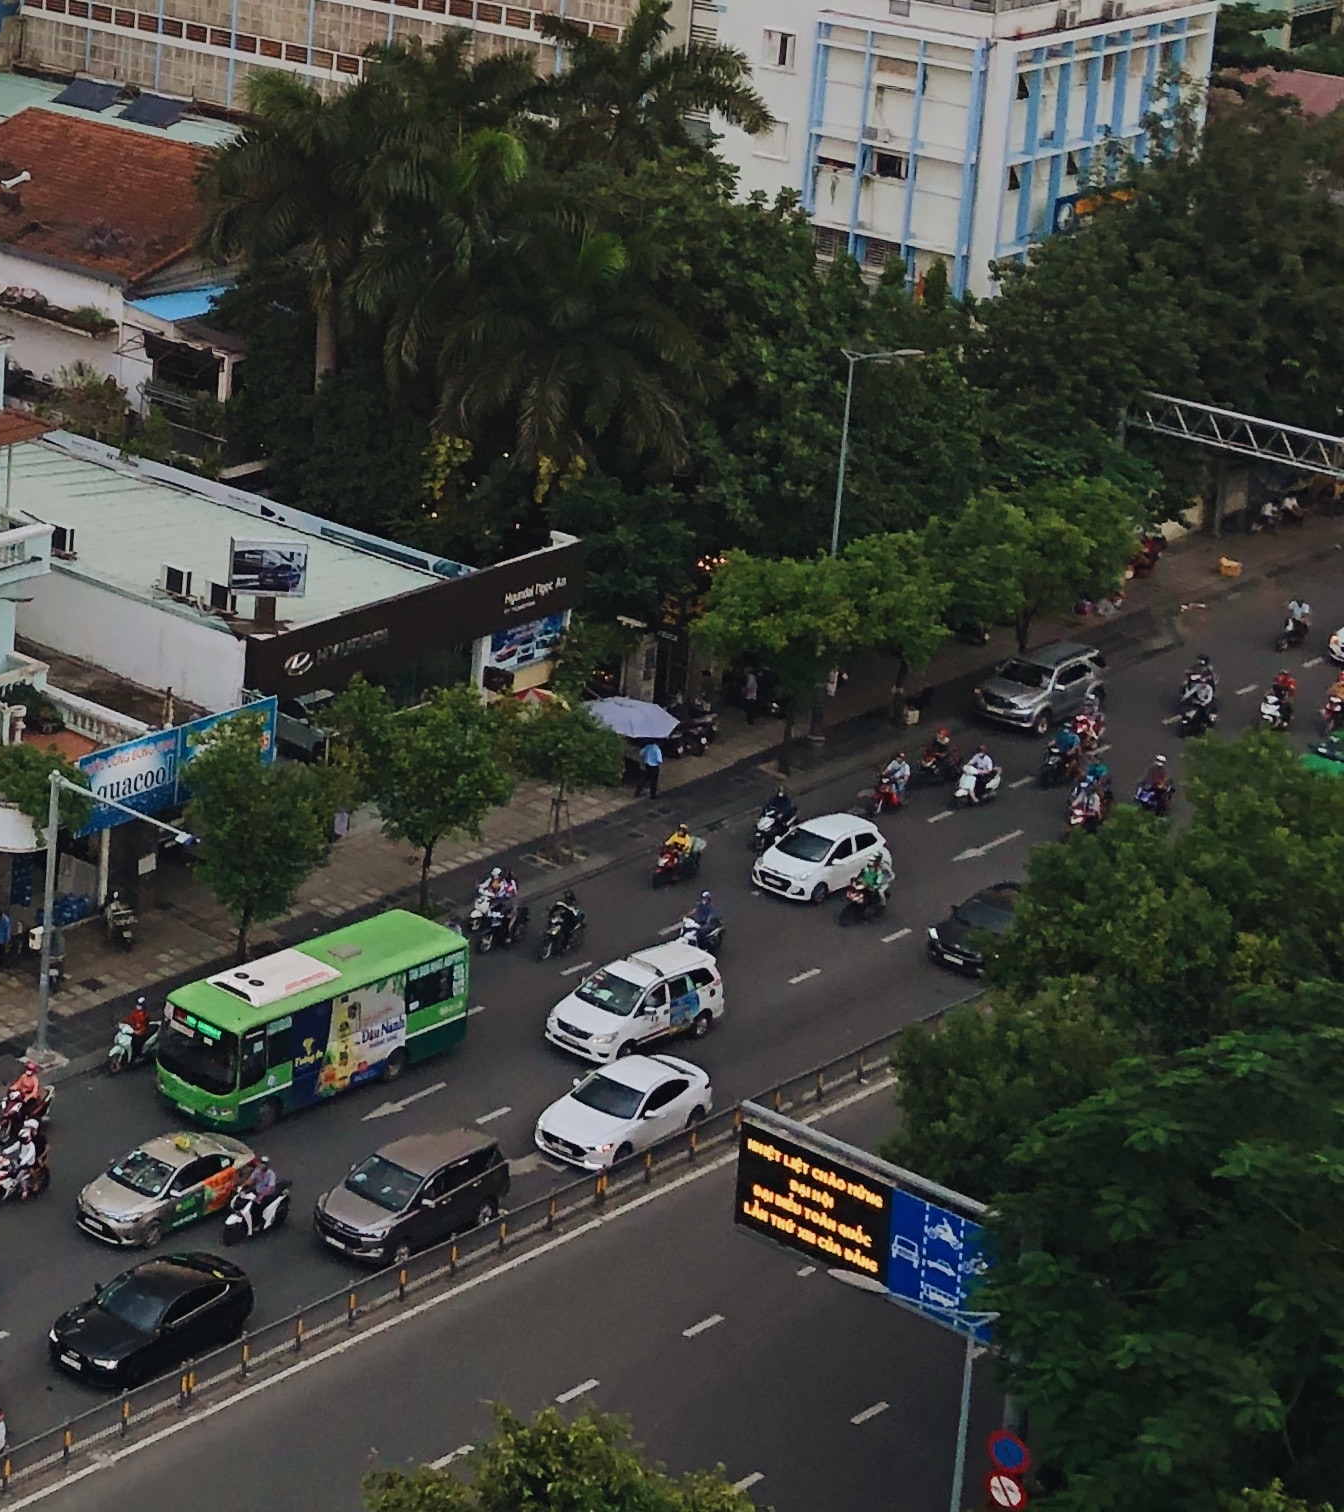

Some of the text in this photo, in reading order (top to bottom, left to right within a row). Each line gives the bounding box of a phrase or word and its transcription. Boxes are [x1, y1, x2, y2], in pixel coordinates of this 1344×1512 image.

[747, 1138, 884, 1209] NHIỆT LIỆT CHÀO MỪNG
[789, 1179, 835, 1209] ĐẠI HỘI
[743, 1199, 769, 1223] LẦN
[770, 1213, 797, 1234] THỨ
[817, 1236, 842, 1257] CỦA
[843, 1248, 879, 1273] ĐẢNG
[752, 1184, 873, 1248] ĐẠI BIỂU TOÀN QUỐC
